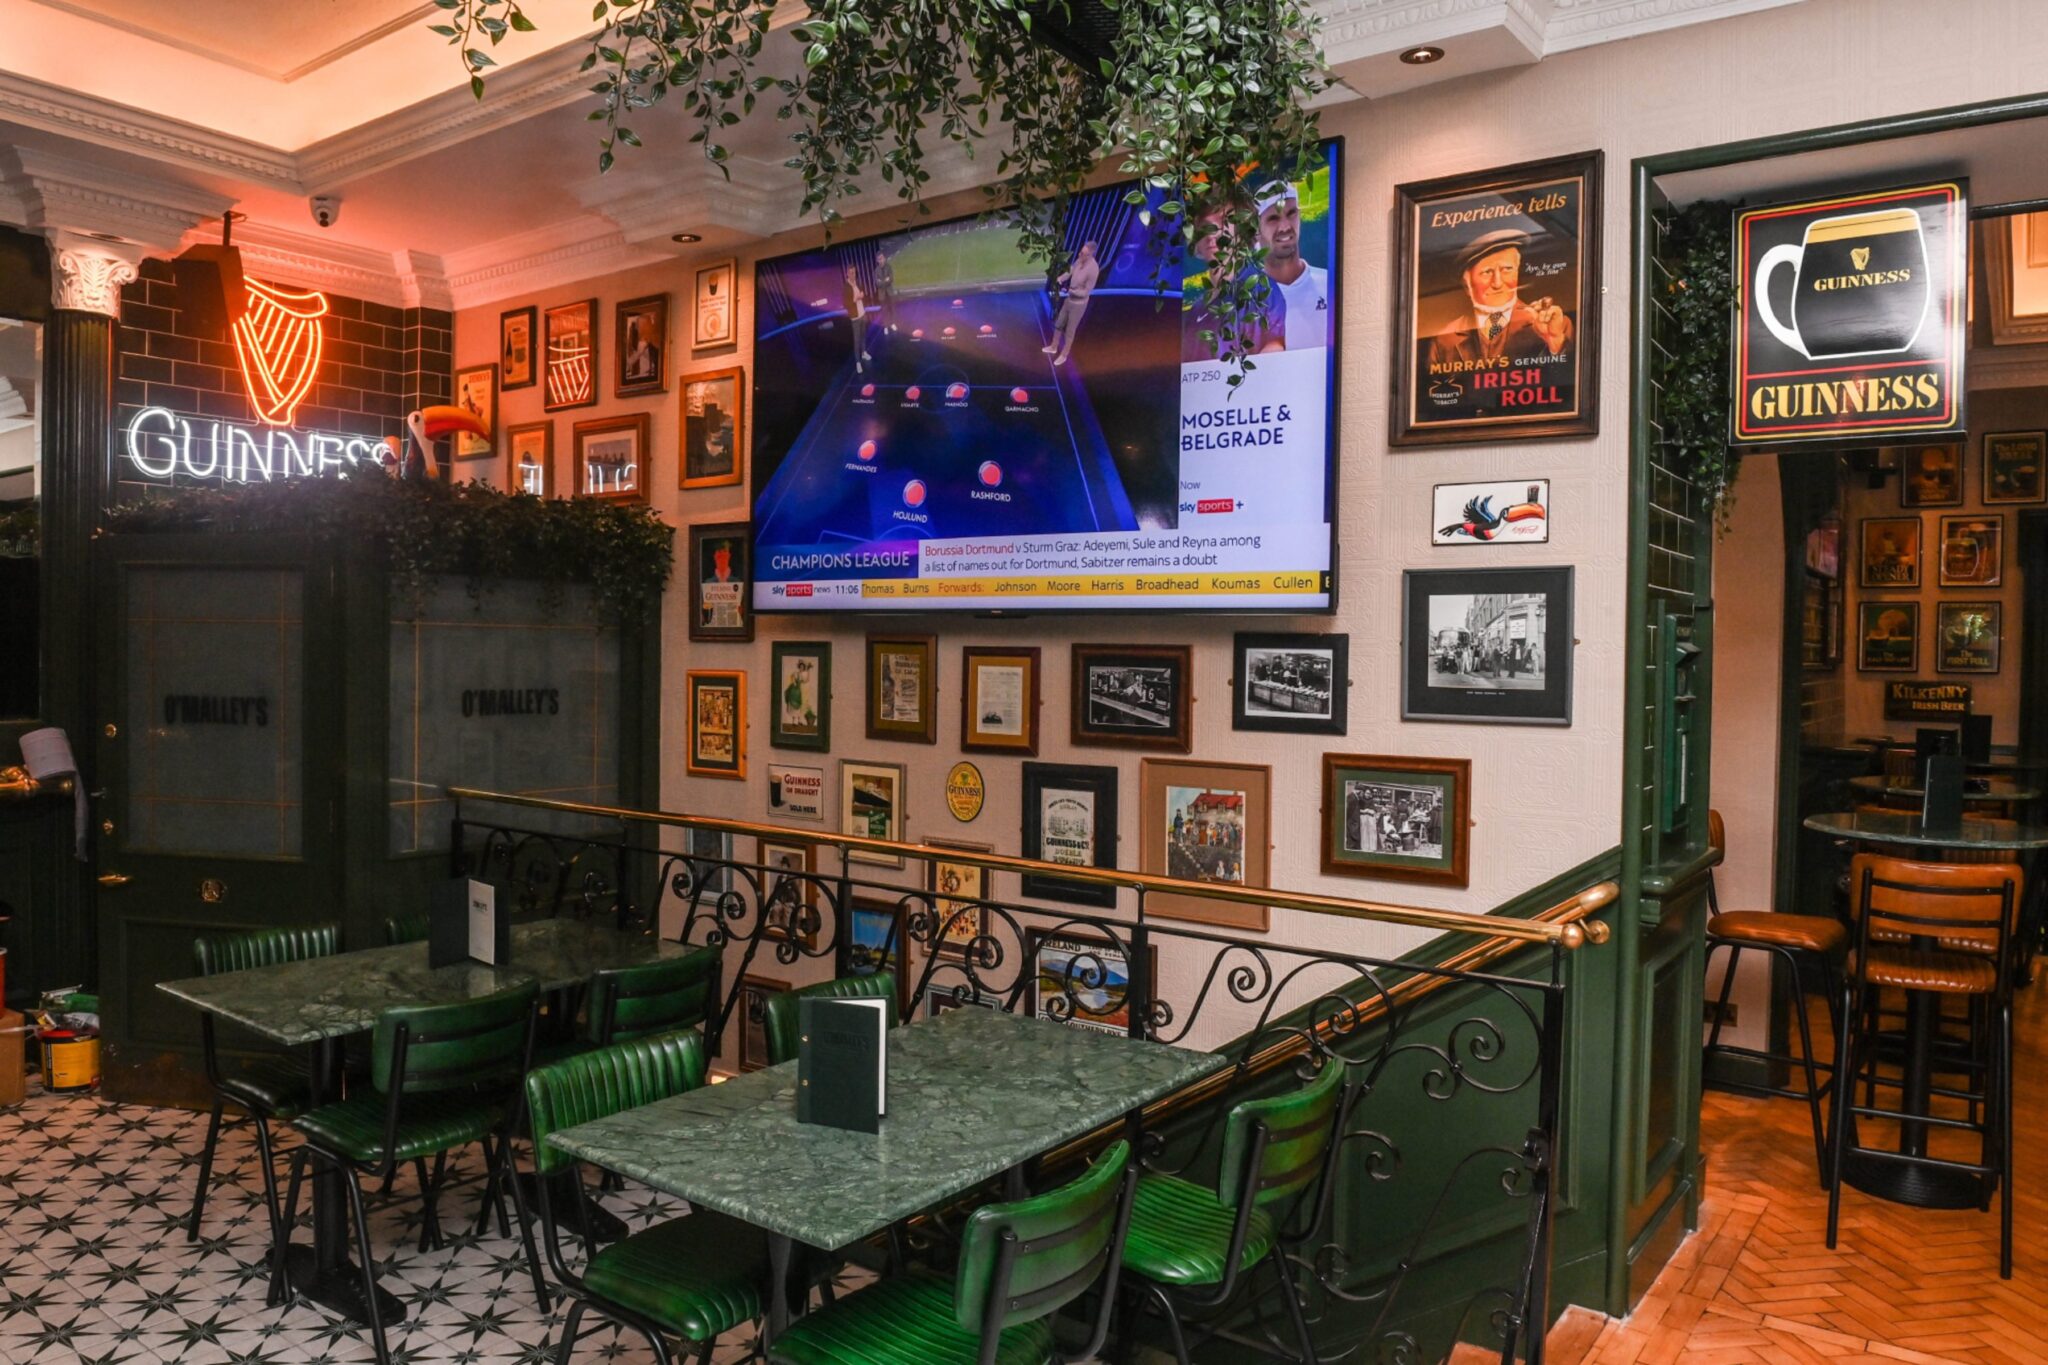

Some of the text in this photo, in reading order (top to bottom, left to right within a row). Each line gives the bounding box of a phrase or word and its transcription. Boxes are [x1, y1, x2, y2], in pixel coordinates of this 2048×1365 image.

[1431, 193, 1567, 228] Experience tells
[1814, 268, 1911, 292] GUINNESS
[1429, 354, 1567, 375] MURRAY'S GENUINE
[1181, 370, 1221, 384] ATP 250
[1474, 368, 1541, 389] IRISH
[1502, 386, 1563, 407] ROLL
[1752, 373, 1939, 420] GUINNESS
[1182, 404, 1291, 430] MOSELLE &
[1181, 427, 1284, 451] BELGRADE
[845, 463, 878, 474] FERNANDES
[1180, 481, 1201, 490] Now
[971, 490, 1011, 503] RASHFORD
[1179, 501, 1196, 513] sky
[1198, 500, 1233, 513] sports
[925, 544, 964, 556] Borussia
[965, 543, 1014, 556] Dortmund
[1015, 545, 1023, 553] v
[1023, 542, 1054, 554] Sturm
[1083, 539, 1131, 553] Adeyemi,
[1132, 537, 1156, 550] Sule
[1158, 536, 1180, 549] and
[1182, 536, 1217, 550] Reyna
[1219, 536, 1261, 549] among
[772, 551, 910, 570] CHAMPIONS LEAGUE
[925, 554, 1218, 572] a list of names out for Dortmund, Sabitzer remains a doubt
[772, 585, 859, 596] sky sports news 11:06
[903, 583, 930, 593] Burns
[938, 582, 985, 593] Forwards:
[994, 581, 1037, 593] Johnson
[1047, 580, 1081, 591] Moore
[1091, 579, 1125, 591] Harris
[1136, 578, 1199, 591] Broadhead
[1211, 577, 1260, 589] Koumas
[1273, 576, 1313, 588] Cullen
[1893, 684, 1967, 699] KILKENNY
[164, 694, 268, 726] O'MALLEY'S
[462, 689, 559, 718] O'MALLEY'S
[784, 774, 821, 787] GUINNESS
